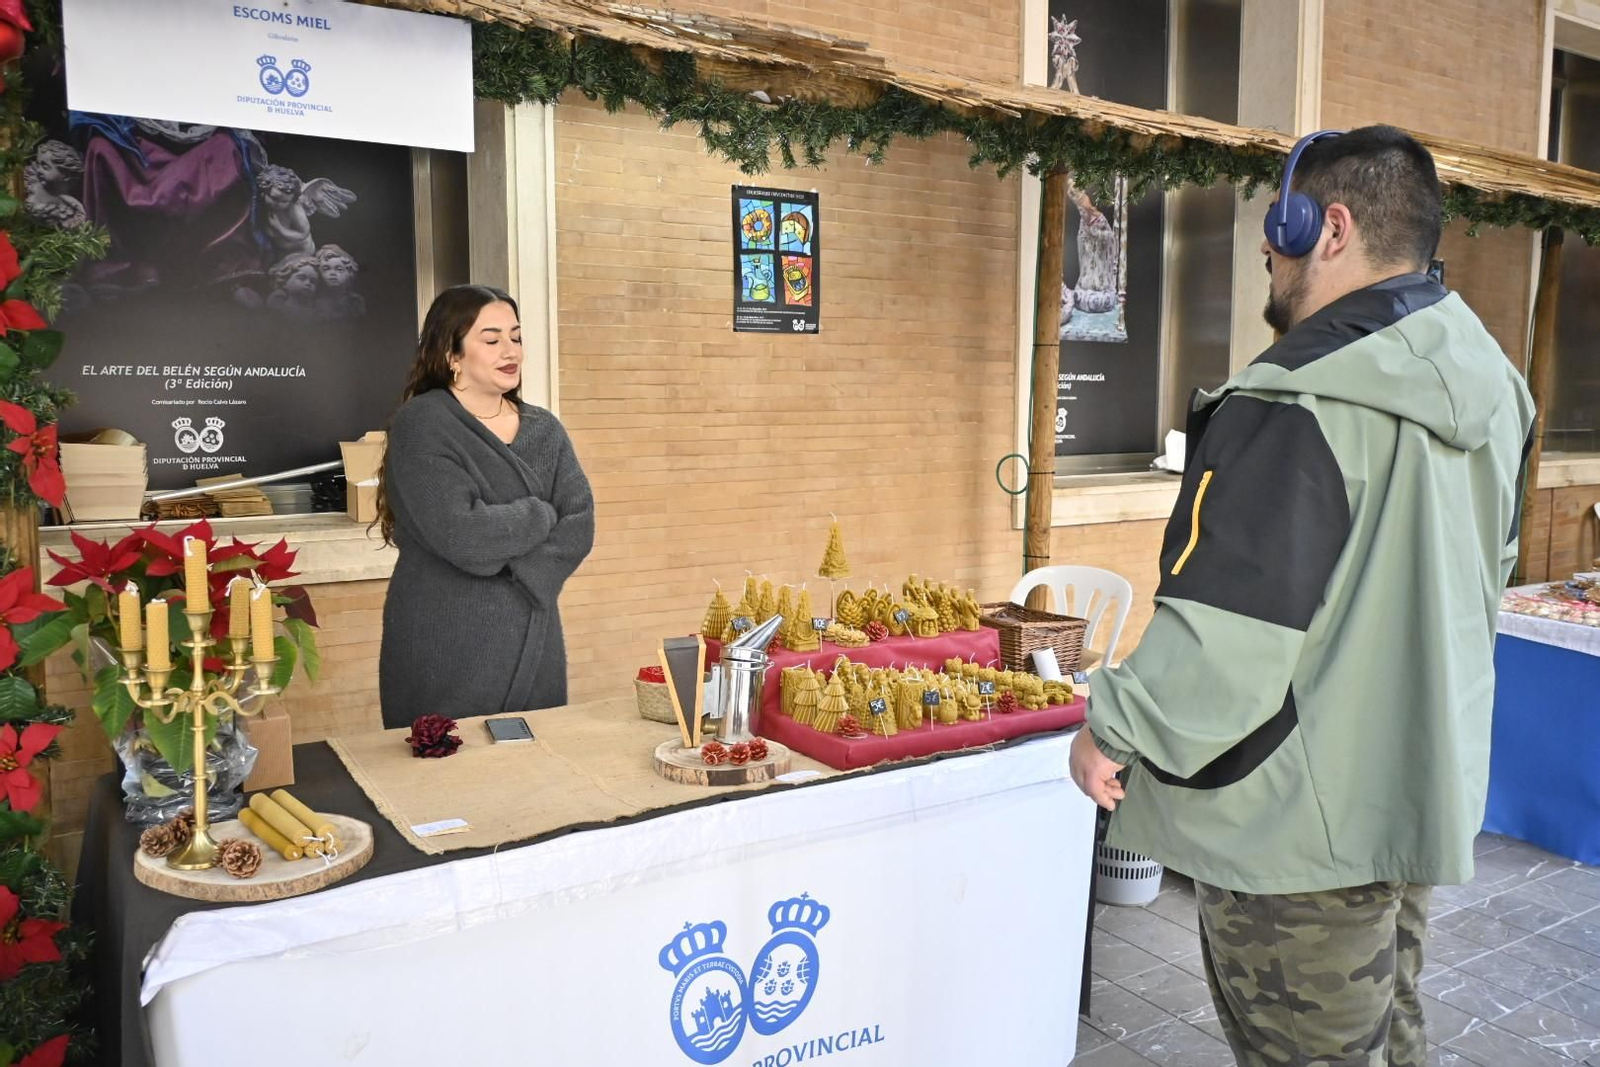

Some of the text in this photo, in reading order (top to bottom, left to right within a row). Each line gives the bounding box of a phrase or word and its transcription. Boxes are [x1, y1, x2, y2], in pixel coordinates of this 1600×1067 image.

[233, 5, 331, 30] ESCOMS MIEL
[236, 95, 333, 113] DIPUTACIÓN PROVINCIAL
[275, 108, 305, 116] HUELVA
[82, 363, 306, 377] EL ARTE DEL BELÉN SEGÚN ANDALUCÍA
[185, 378, 233, 391] Edición)
[153, 455, 247, 464] DIPUTACIÓN PROVINCIAL
